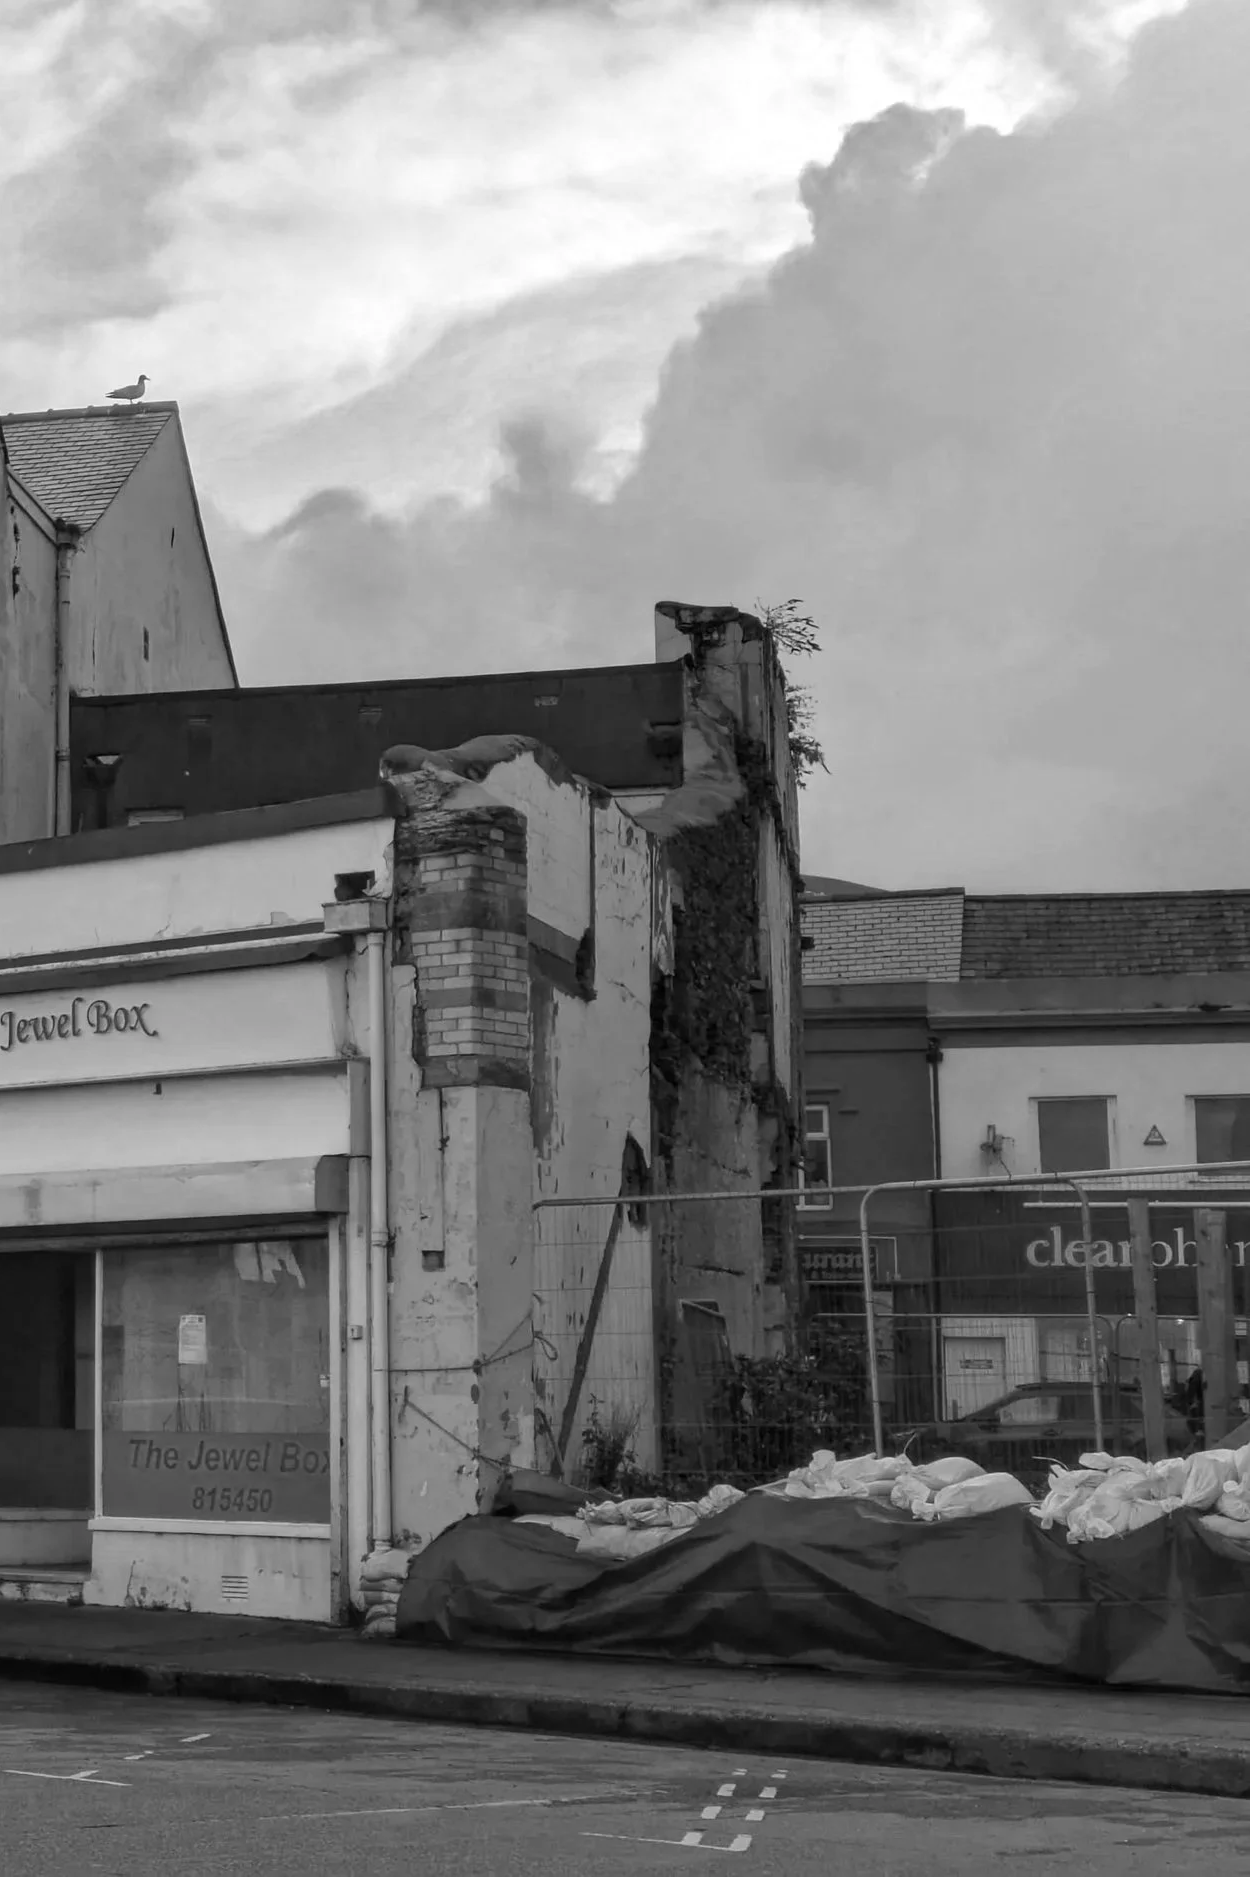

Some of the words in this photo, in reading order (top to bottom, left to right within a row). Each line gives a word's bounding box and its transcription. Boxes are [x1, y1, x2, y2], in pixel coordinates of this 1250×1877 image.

[0, 997, 85, 1051] Jewel
[87, 1000, 159, 1037] Box
[129, 1439, 179, 1470] The
[188, 1440, 271, 1473] Jewel
[192, 1486, 273, 1513] 815450
